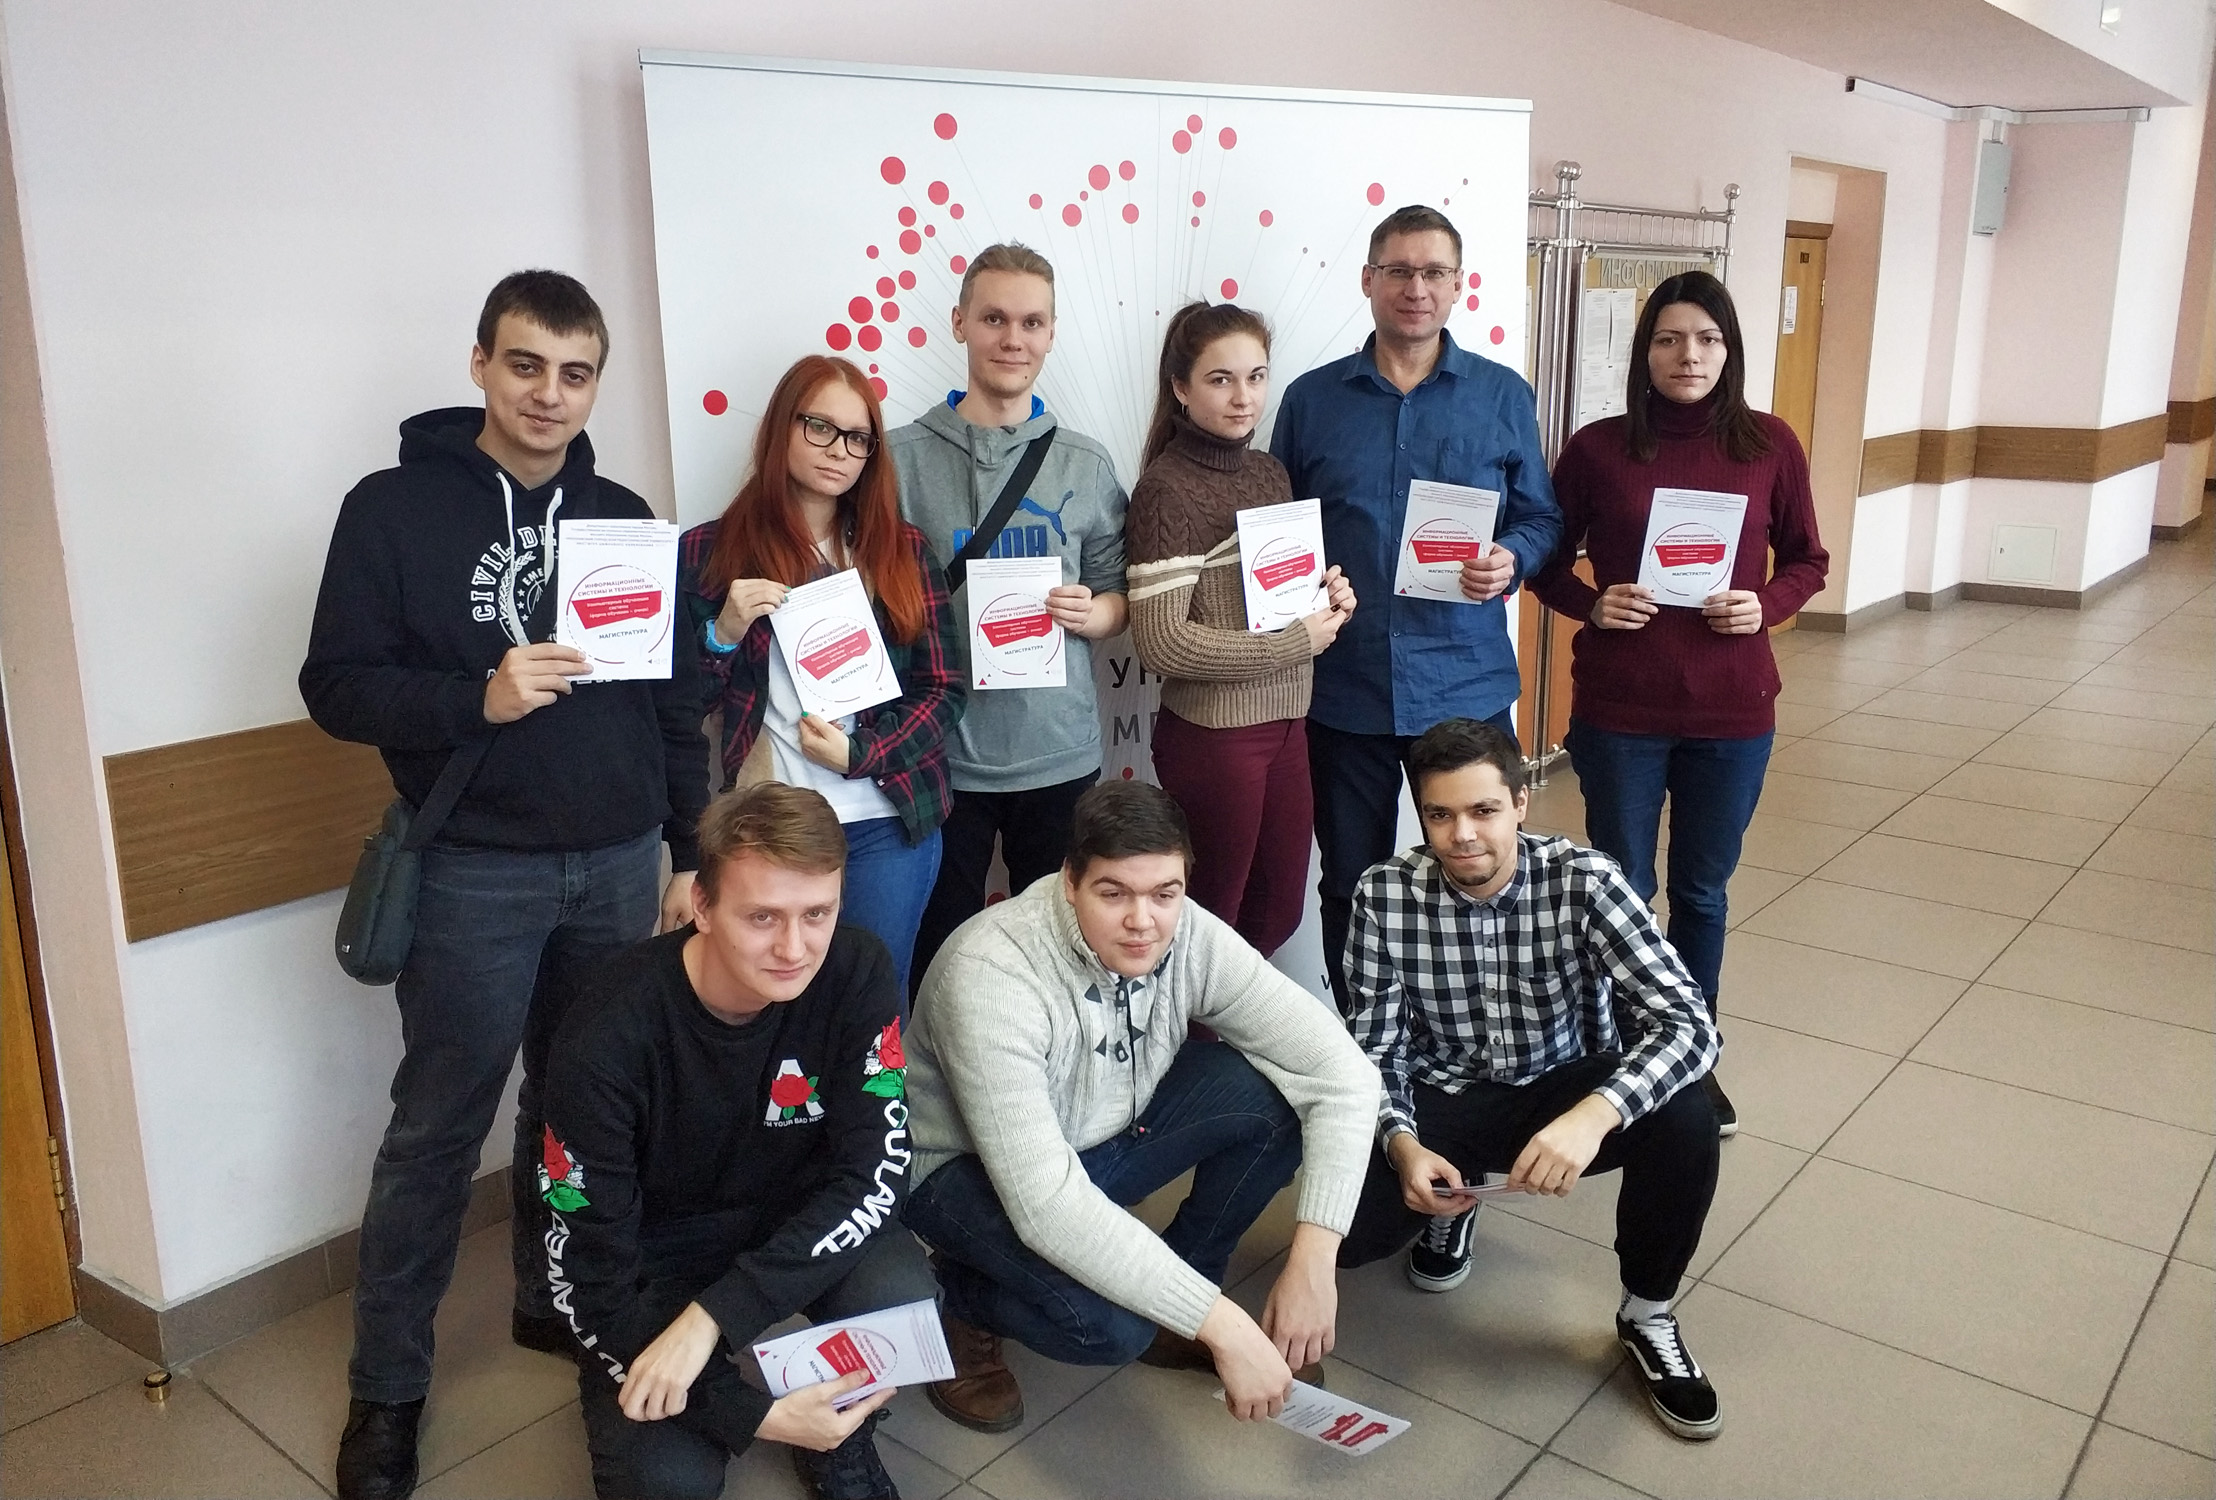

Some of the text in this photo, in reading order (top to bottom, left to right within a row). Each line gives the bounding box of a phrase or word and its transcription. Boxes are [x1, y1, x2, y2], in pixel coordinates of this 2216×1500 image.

[953, 525, 1048, 558] PMA
[471, 541, 516, 622] CIVIL
[584, 578, 645, 589] ИНФОРМАЦИОННЫЕ
[578, 589, 608, 597] СИСТЕМЫ
[614, 584, 654, 593] ТЕХНОЛОГИИ
[599, 628, 648, 639] МАГИСТРАТУРА
[773, 1120, 793, 1128] YOUR
